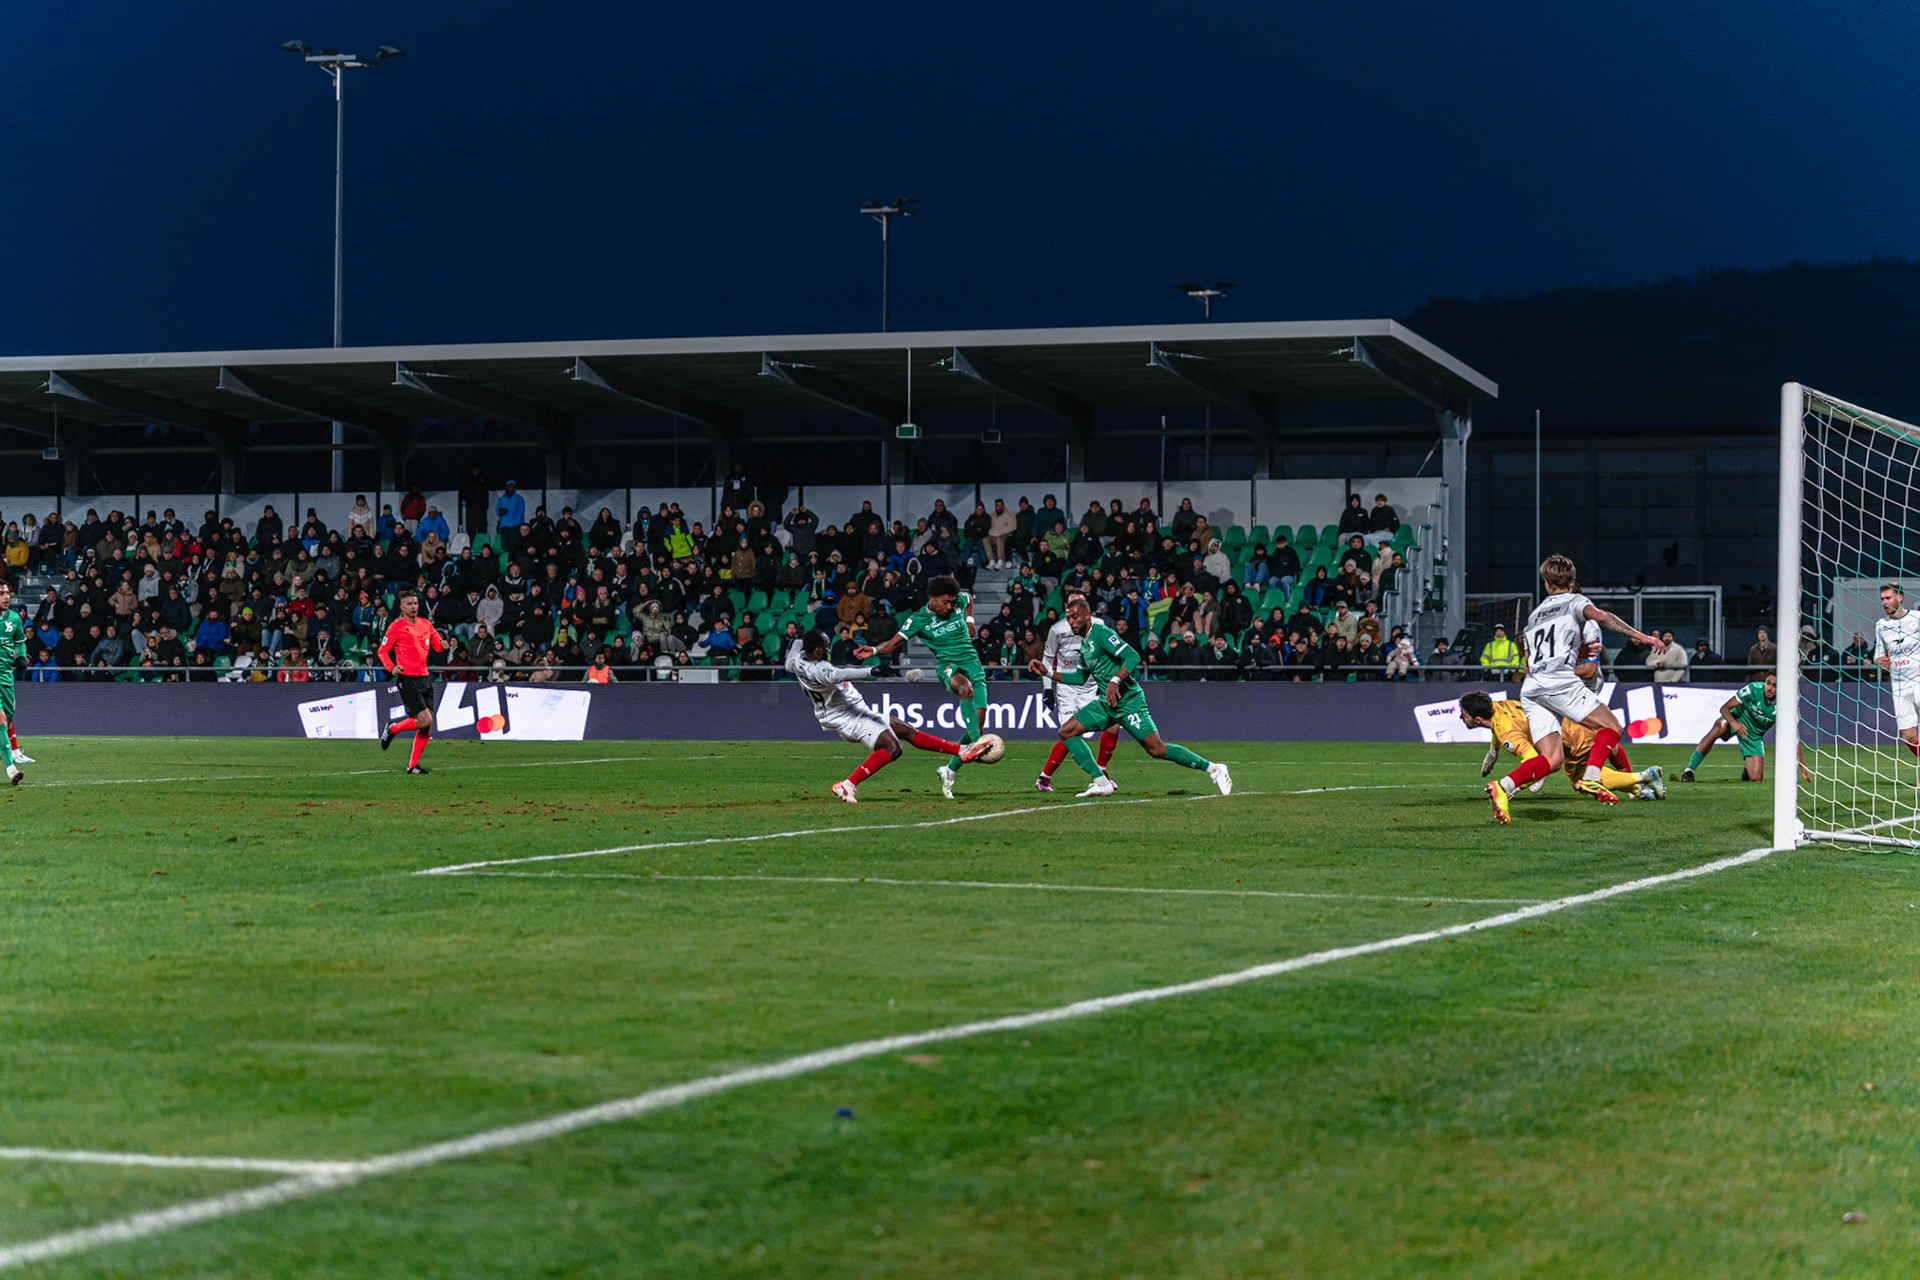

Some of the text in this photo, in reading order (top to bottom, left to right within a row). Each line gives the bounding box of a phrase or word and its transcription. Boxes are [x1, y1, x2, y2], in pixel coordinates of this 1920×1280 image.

[1533, 623, 1556, 664] 21
[309, 703, 334, 713] UBS key4
[1428, 706, 1456, 717] UBS key4
[1127, 712, 1142, 725] 21
